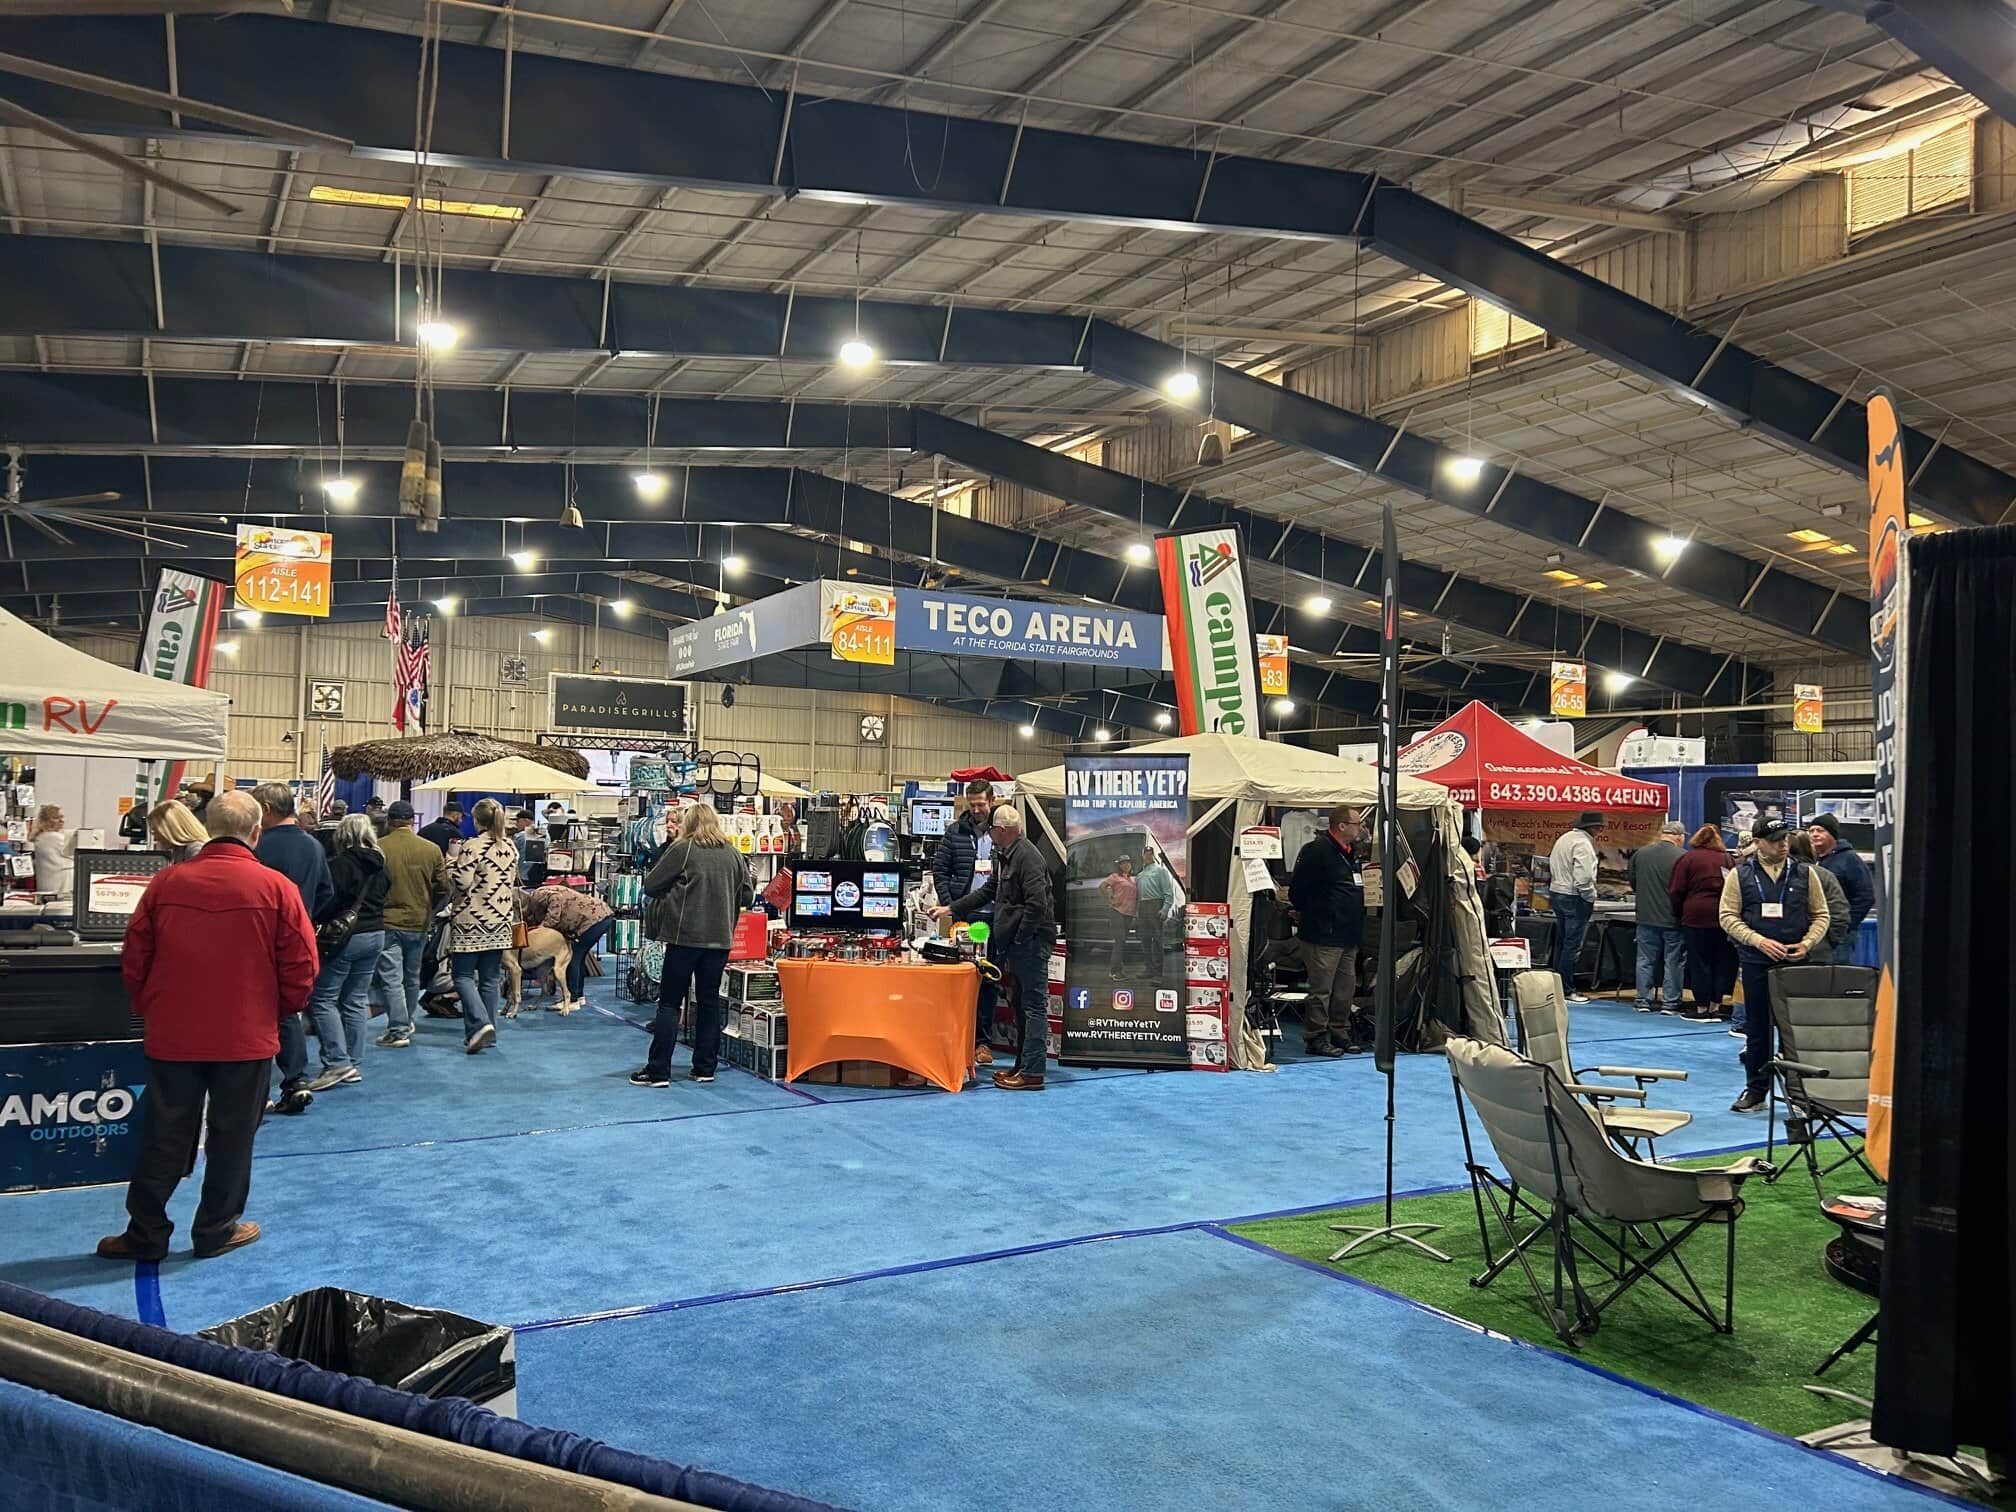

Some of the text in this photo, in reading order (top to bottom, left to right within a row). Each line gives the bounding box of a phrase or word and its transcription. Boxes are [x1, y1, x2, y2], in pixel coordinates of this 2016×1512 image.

[271, 567, 297, 577] AISLE
[245, 575, 323, 606] 112-141
[714, 621, 744, 642] FLORIDA
[855, 624, 873, 633] AISLE
[922, 600, 1138, 649] TECO ARENA
[838, 630, 892, 656] 84-111
[953, 636, 1120, 660] AT THE FLORIDA STATE FAIRGROUNDS
[1555, 694, 1583, 710] 26-55
[43, 696, 118, 734] RV
[562, 703, 679, 719] PARADISE GRILLS
[1799, 711, 1819, 726] 1-25
[1067, 770, 1187, 796] RV THERE YET?
[1489, 782, 1661, 807] 843.390.4386 (4FUN)
[1072, 799, 1179, 809] ROAD TRIP TO EXPLORE AMERICA
[1511, 818, 1541, 829] Beach's
[1542, 820, 1574, 830] Newes
[1519, 831, 1535, 840] and
[1537, 831, 1551, 843] Dry
[1087, 1018, 1161, 1029] @RVThereYetTV
[1066, 1030, 1182, 1042] www.RVTHEREYETTV.com
[30, 1122, 129, 1141] OUTDOORS
